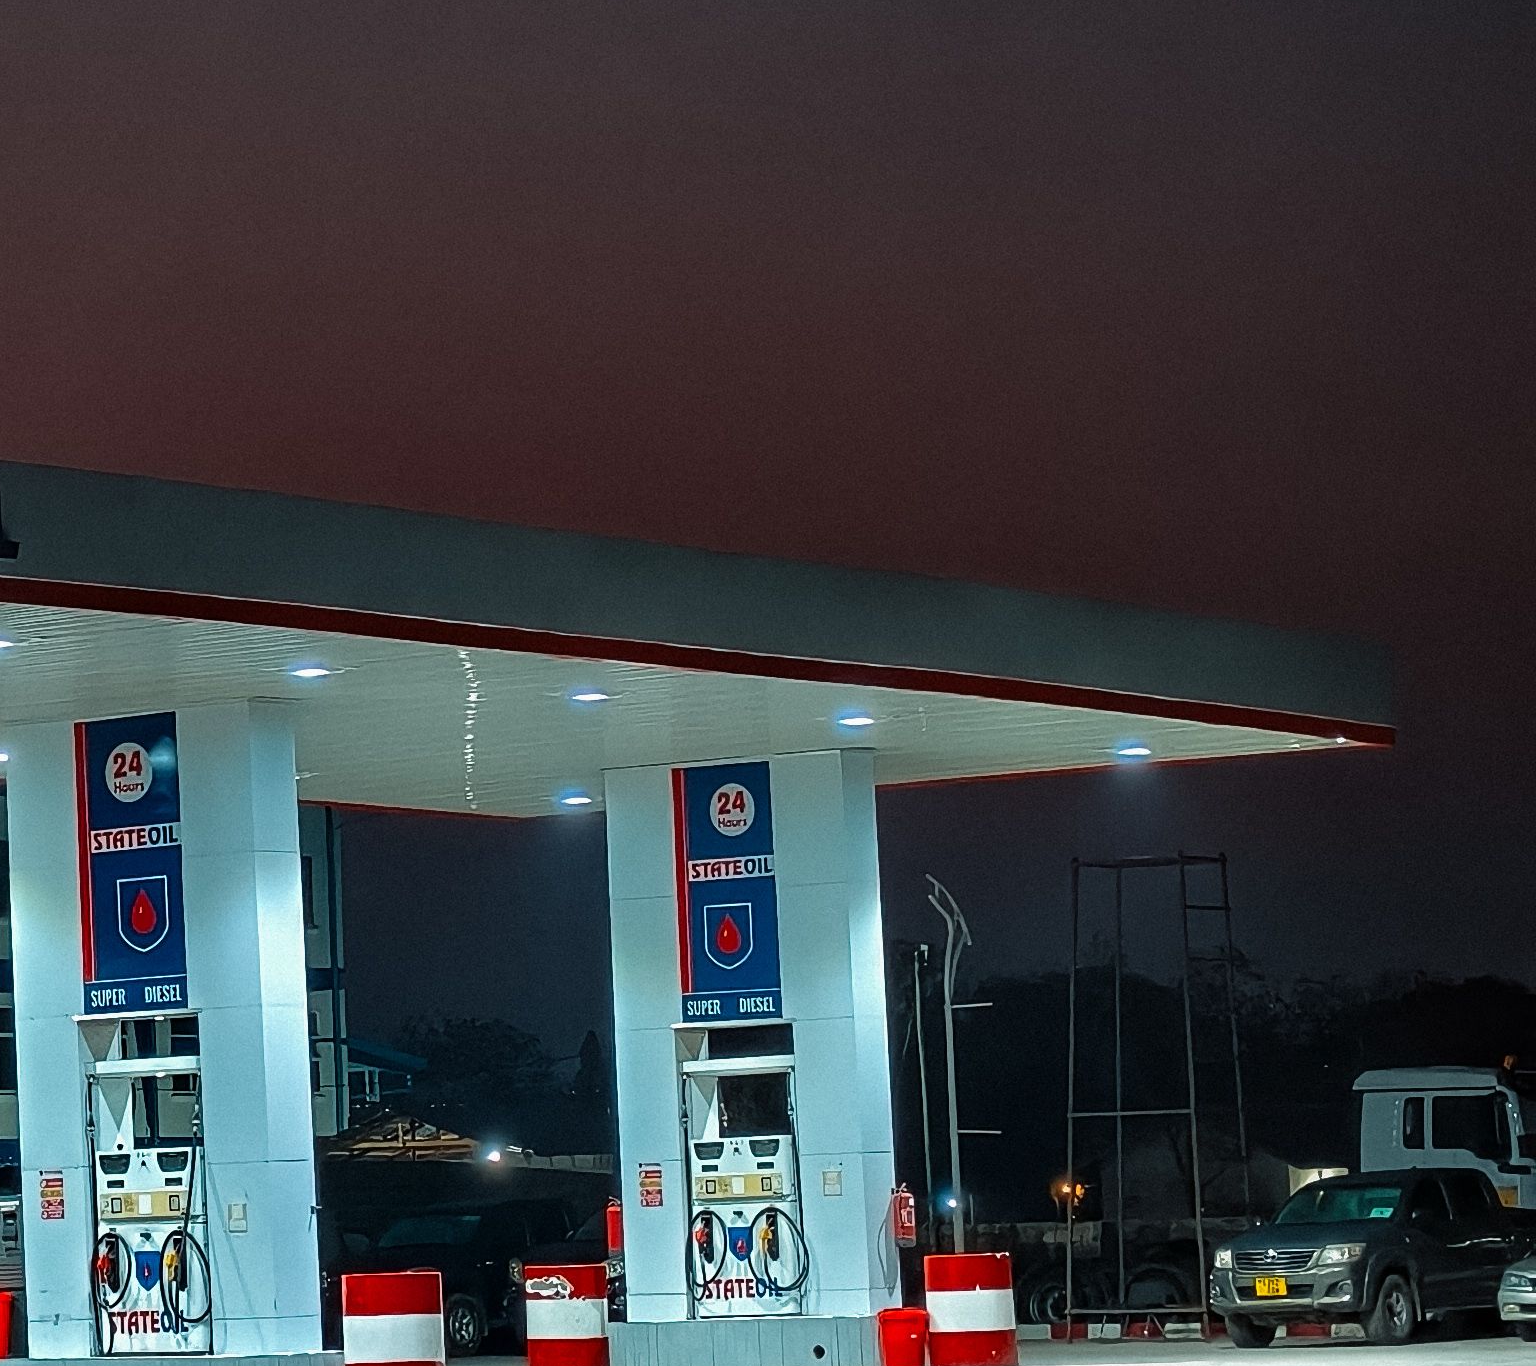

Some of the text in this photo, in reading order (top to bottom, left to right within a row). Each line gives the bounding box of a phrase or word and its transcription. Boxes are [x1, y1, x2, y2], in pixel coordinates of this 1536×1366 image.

[113, 750, 143, 780] 24
[717, 790, 746, 816] 24
[93, 824, 179, 851] STATEOIL
[691, 857, 773, 879] STATEOIL
[90, 984, 182, 1008] SUPER DIESEL
[687, 996, 776, 1016] SUPER DIESEL
